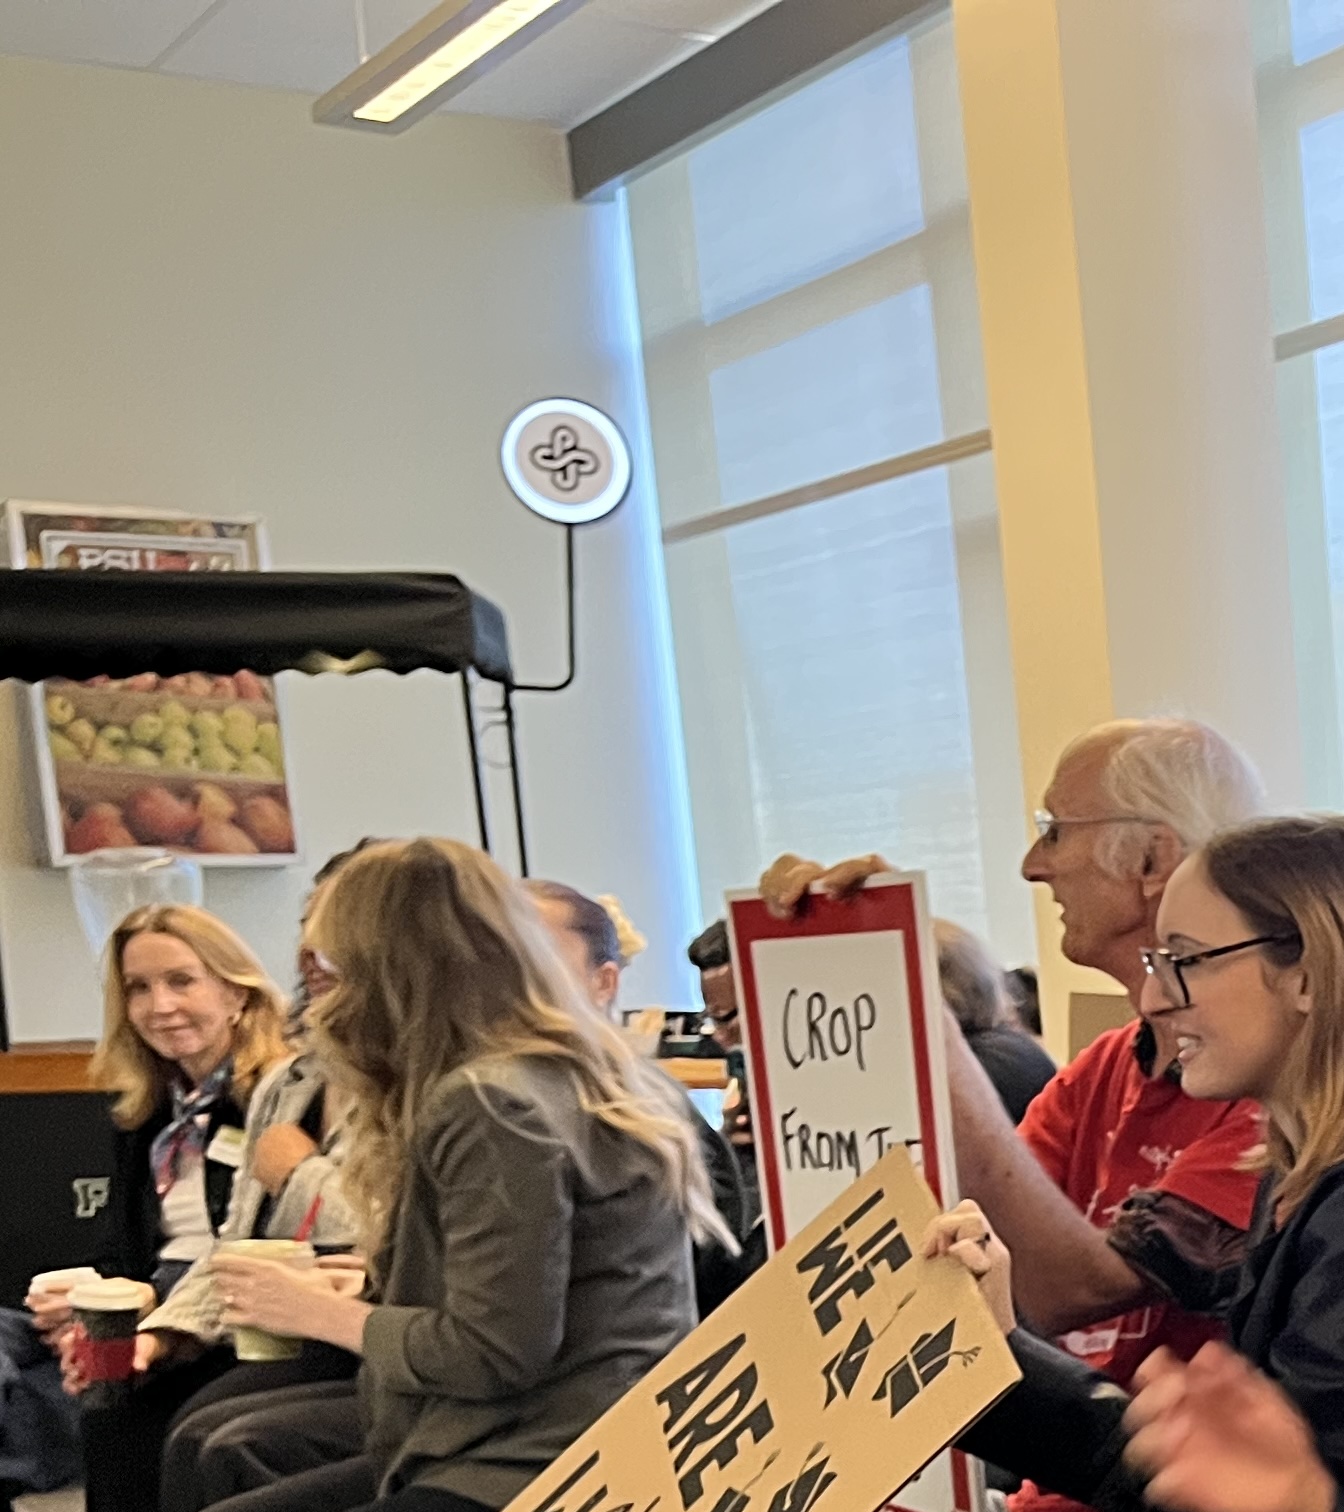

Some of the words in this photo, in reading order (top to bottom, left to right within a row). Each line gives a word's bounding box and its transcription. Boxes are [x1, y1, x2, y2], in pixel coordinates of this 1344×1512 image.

[782, 986, 876, 1071] CROP
[780, 1106, 861, 1178] FROM
[795, 1187, 913, 1336] WE
[654, 1332, 775, 1510] ARE
